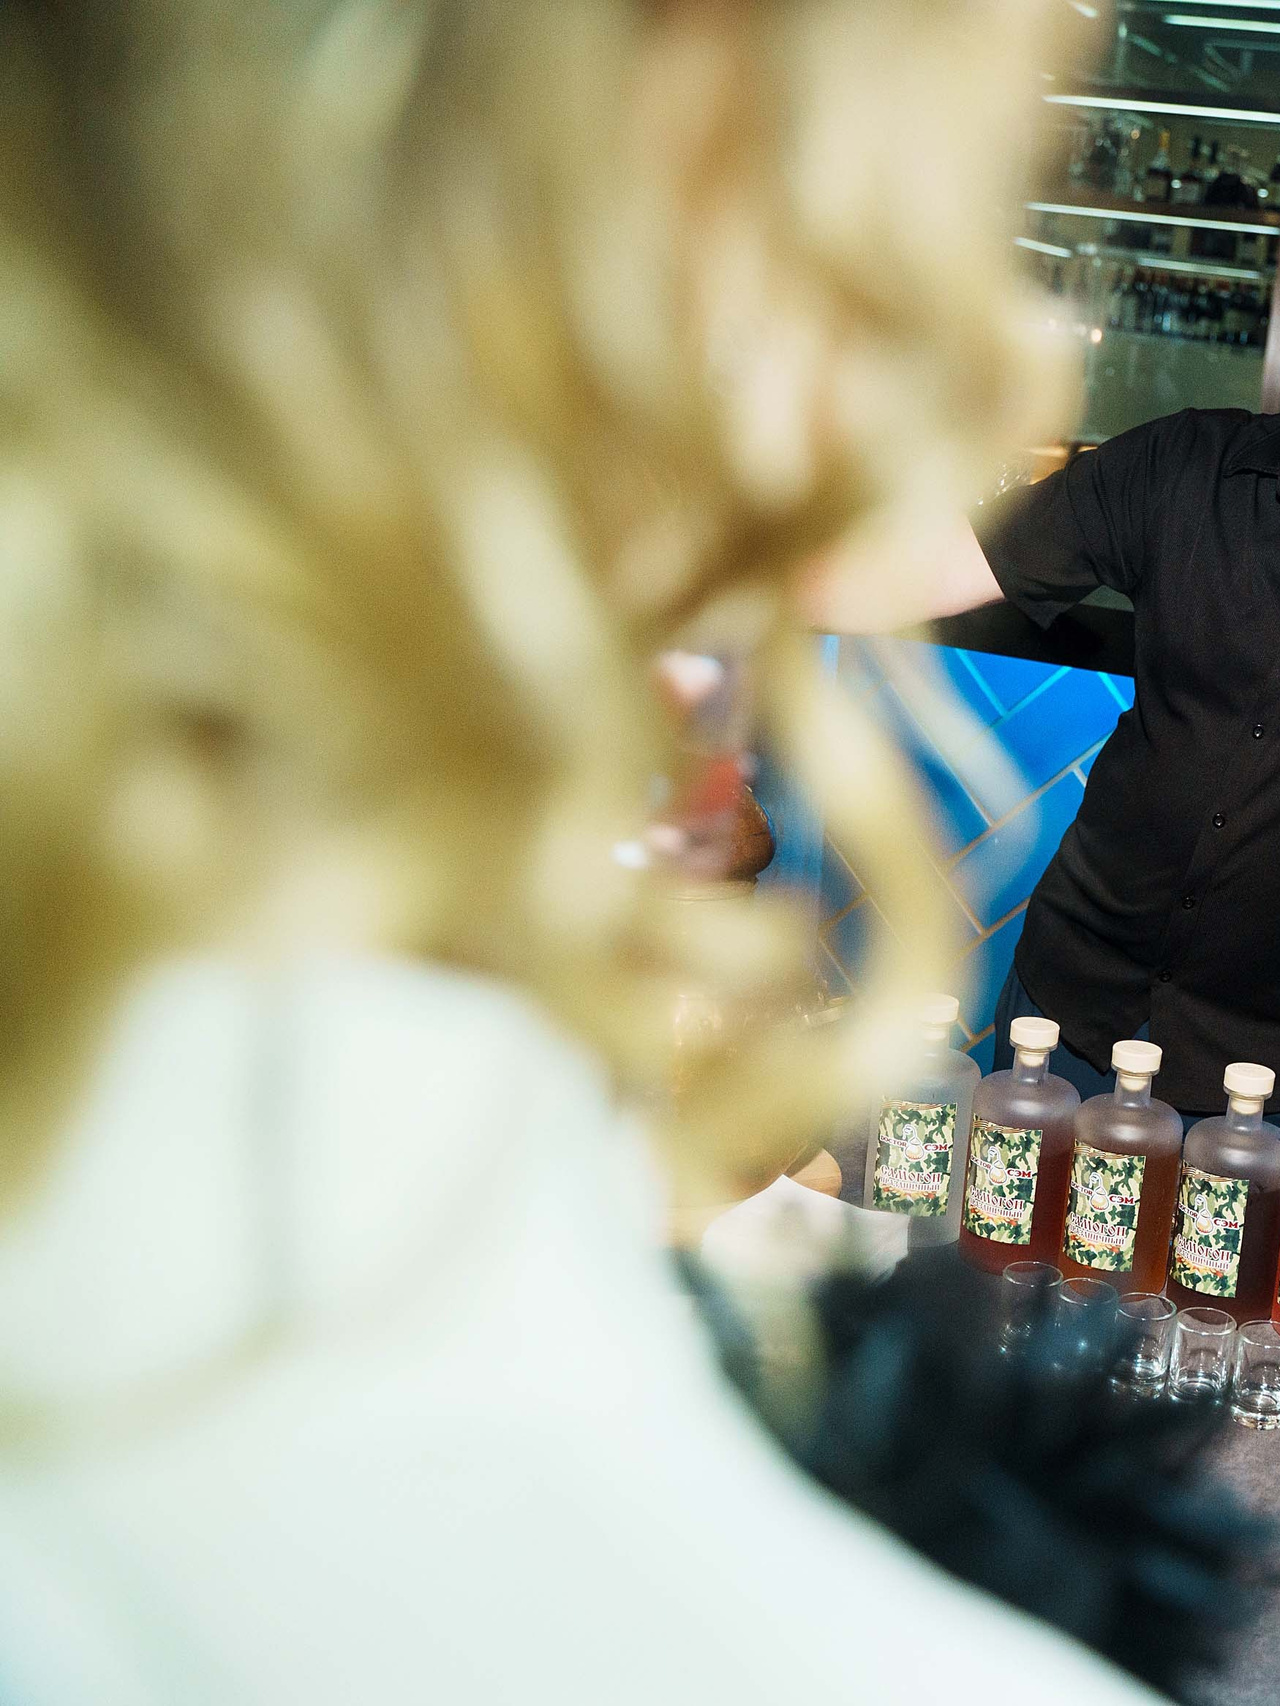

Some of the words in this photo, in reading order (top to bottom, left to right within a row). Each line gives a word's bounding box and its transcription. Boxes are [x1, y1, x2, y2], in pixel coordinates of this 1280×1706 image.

[1007, 1169, 1032, 1178] СЭМ
[1109, 1195, 1135, 1205] СЭМ
[1213, 1218, 1239, 1229] СЭМ
